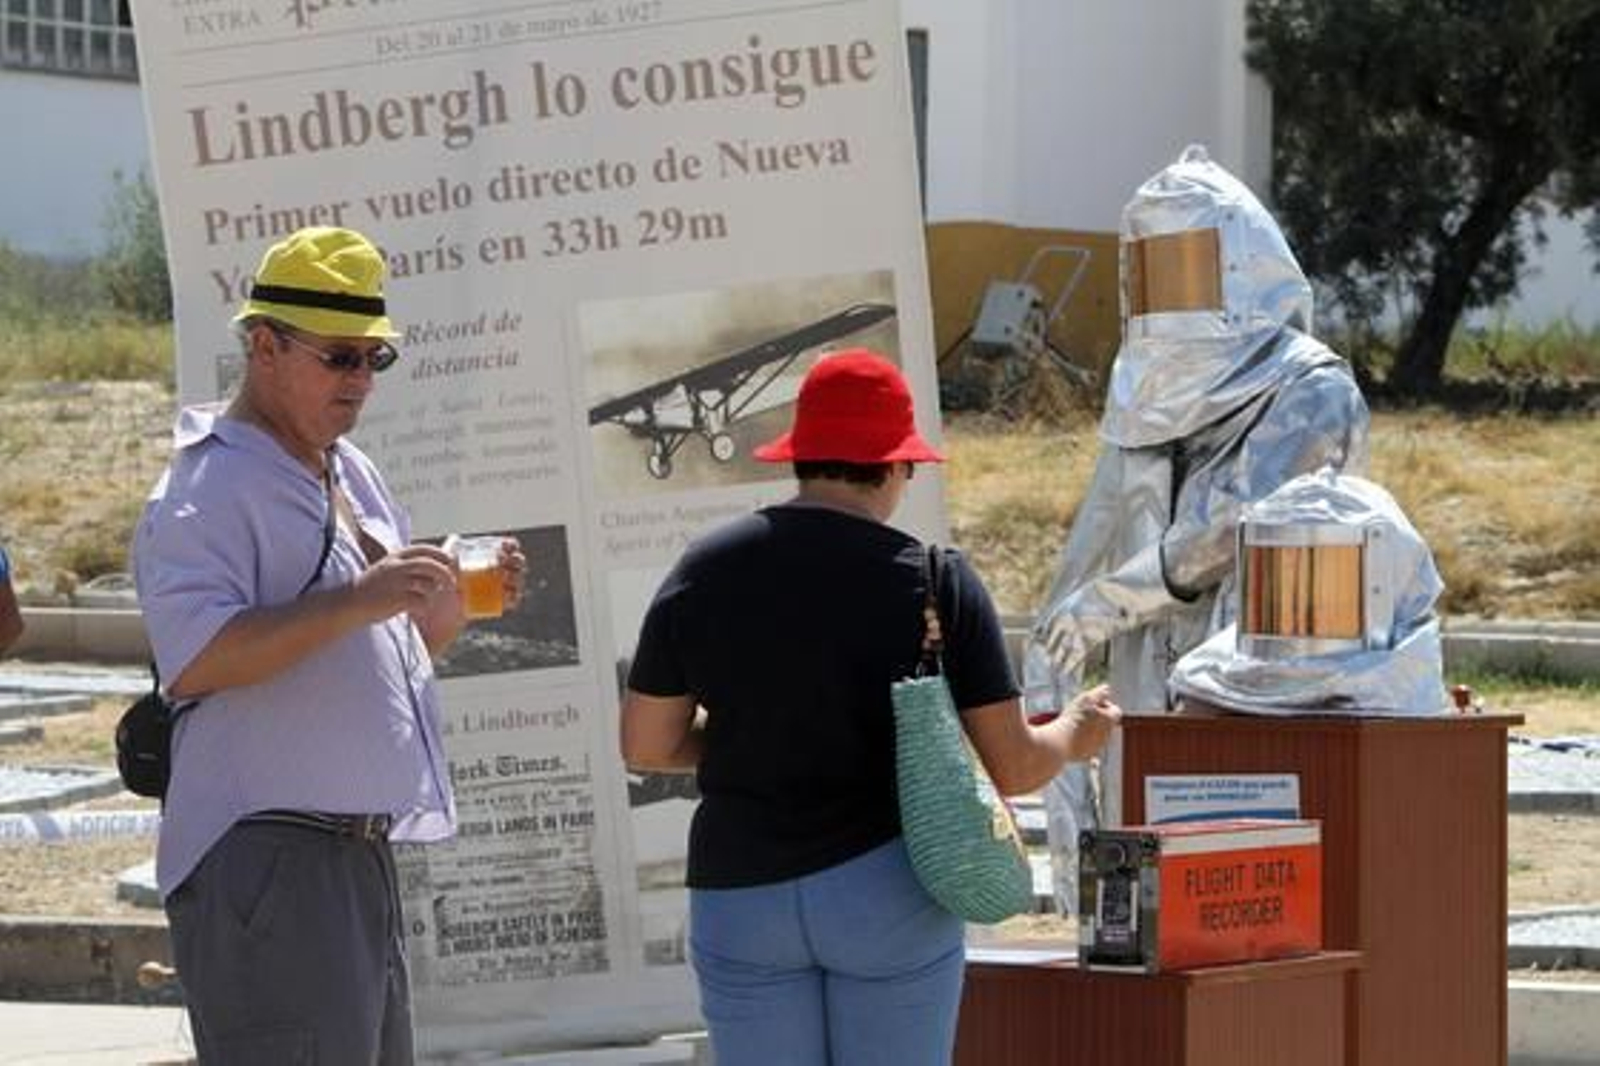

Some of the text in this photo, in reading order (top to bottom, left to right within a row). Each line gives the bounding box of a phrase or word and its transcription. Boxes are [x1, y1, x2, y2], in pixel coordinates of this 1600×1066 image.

[183, 9, 263, 35] EXTRA
[375, 34, 411, 55] Del
[188, 34, 876, 168] Lindbergh lo consigue
[203, 136, 851, 246] Primer vuelo directo de Nueva
[377, 235, 465, 281] arís
[478, 234, 526, 265] en
[542, 216, 619, 258] 33h
[638, 206, 728, 246] 29m
[494, 309, 522, 334] de
[410, 348, 520, 382] distancia
[463, 703, 580, 734] Lindbergh
[1186, 859, 1298, 898] FLIGHT DATA
[1199, 896, 1284, 934] RECORDER
